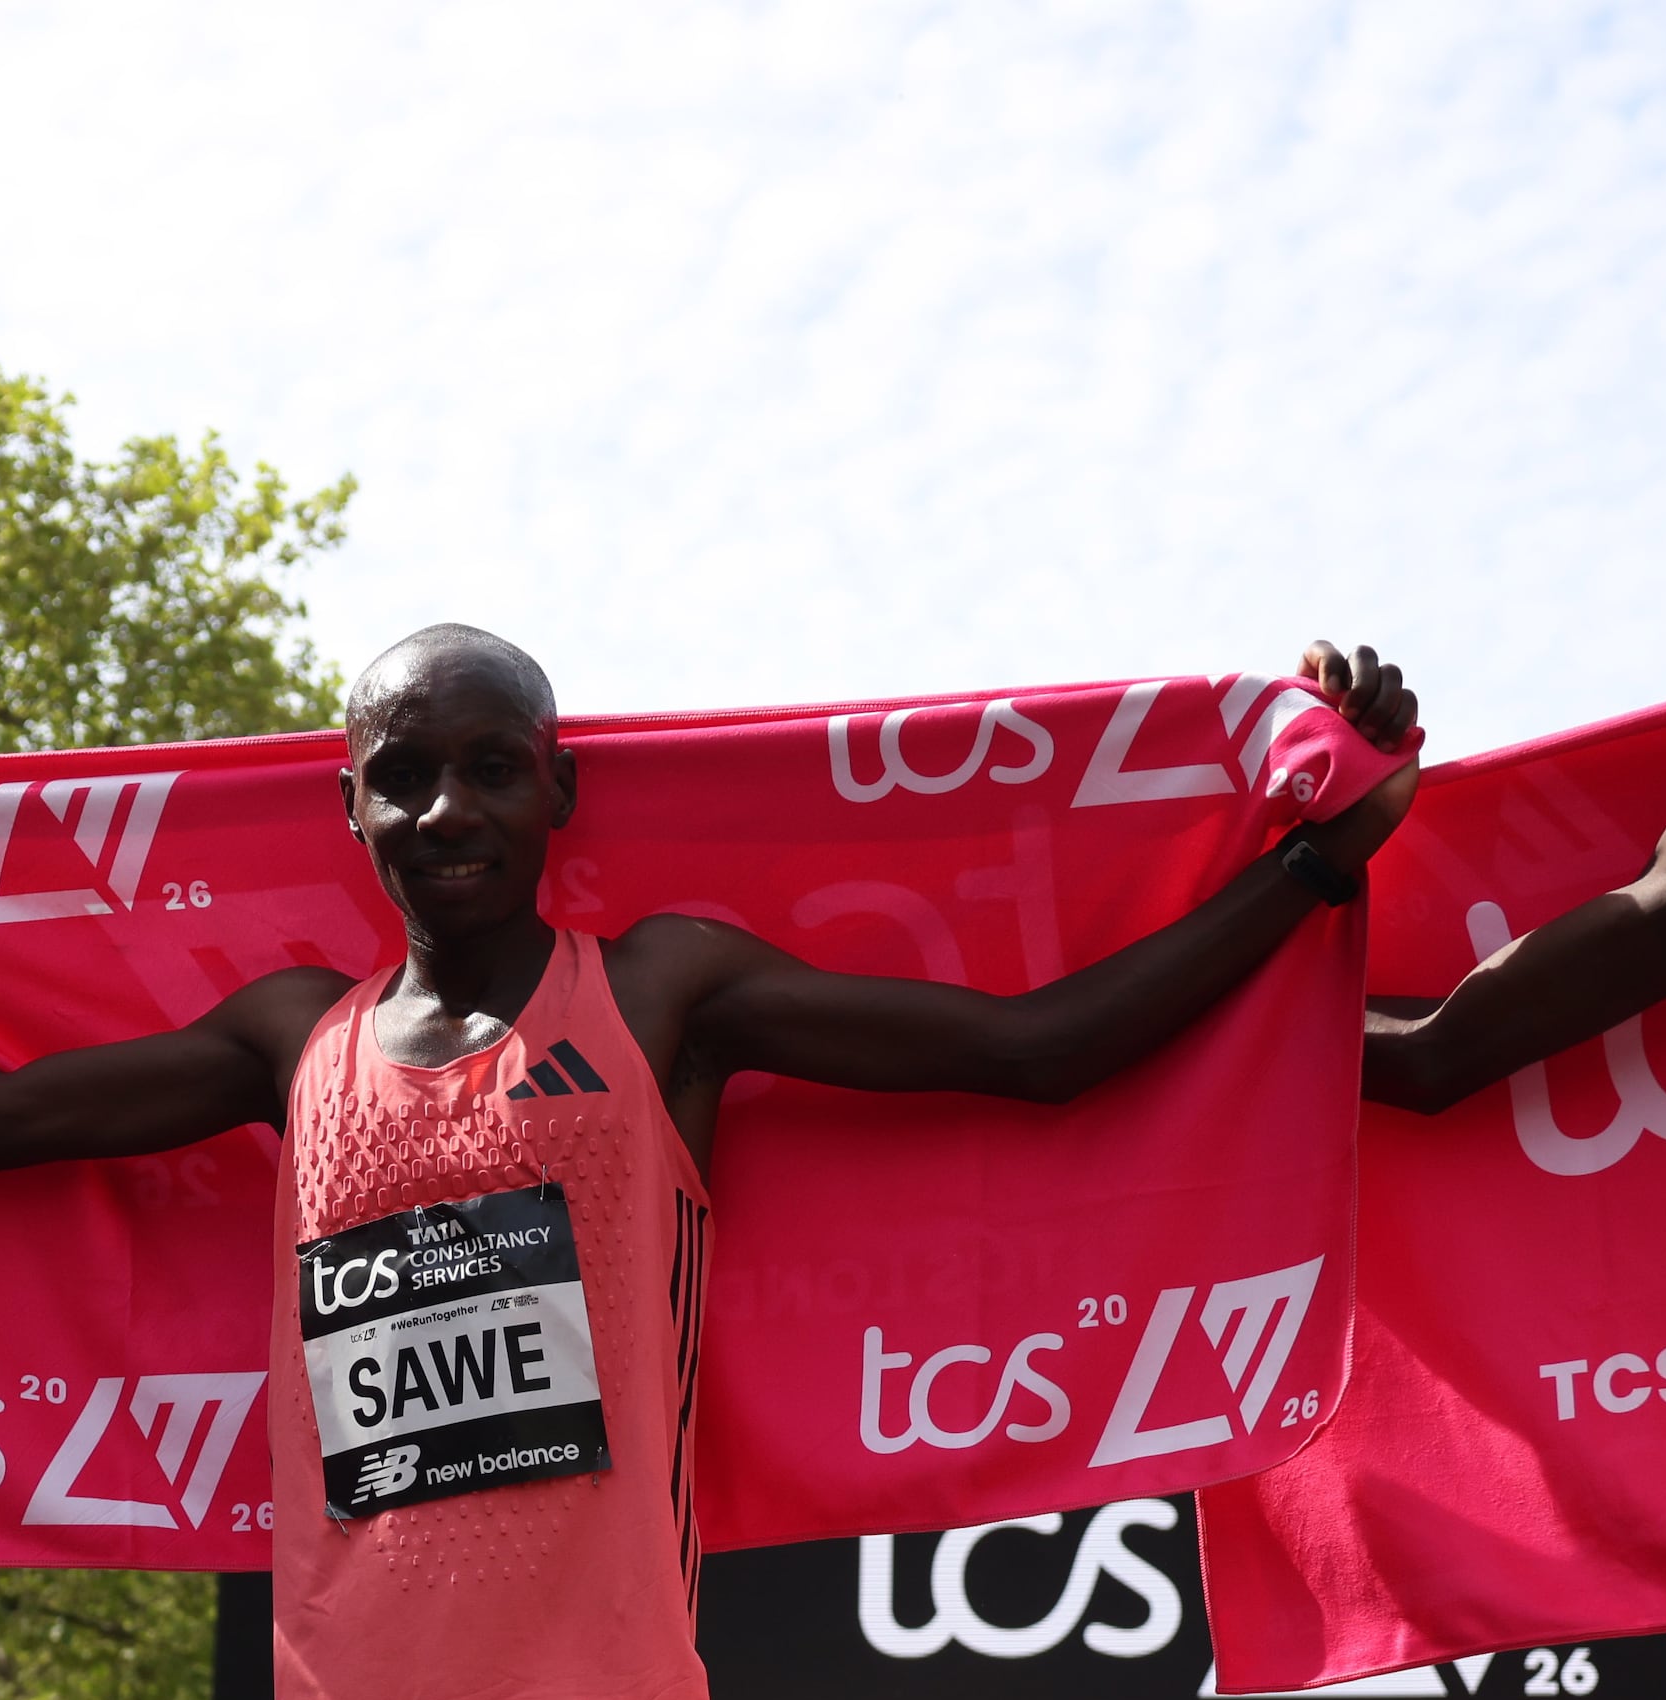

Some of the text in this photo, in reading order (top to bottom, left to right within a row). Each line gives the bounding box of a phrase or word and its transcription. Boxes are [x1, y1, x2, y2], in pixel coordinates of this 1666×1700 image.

[827, 697, 1056, 804] tcs
[1263, 766, 1317, 803] 26
[161, 879, 214, 914] 26
[407, 1218, 467, 1246] TATA
[408, 1226, 552, 1268] CONSULTANCY
[312, 1249, 400, 1316] tcs
[410, 1254, 503, 1292] SERVICES
[389, 1303, 480, 1333] #WeRunTogether
[347, 1320, 552, 1429] SAWE
[858, 1325, 1072, 1455] tcs
[1076, 1293, 1129, 1330] 20
[1279, 1389, 1320, 1430] 26
[19, 1373, 69, 1405] 20
[230, 1503, 275, 1533] 26
[425, 1456, 475, 1487] new
[479, 1441, 581, 1475] balance
[858, 1496, 1184, 1660] tcs
[1523, 1646, 1600, 1697] 26
